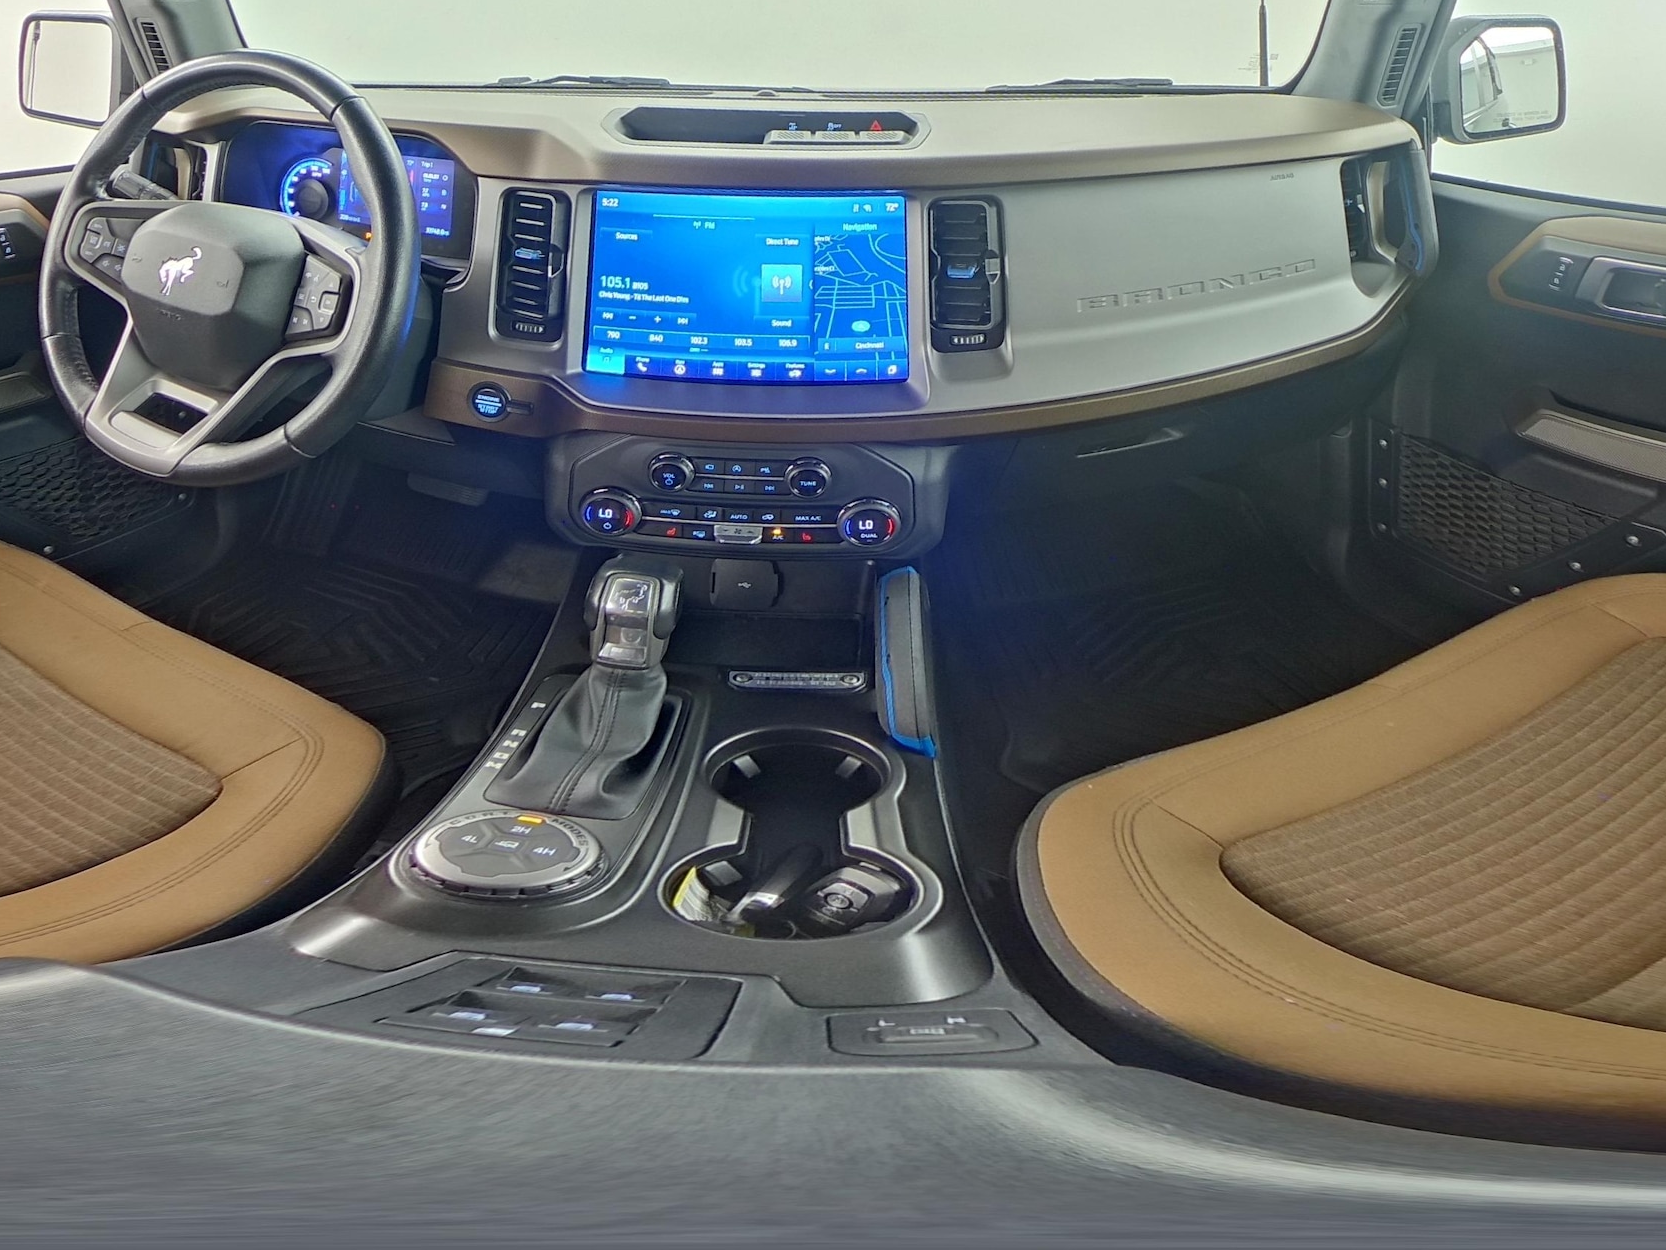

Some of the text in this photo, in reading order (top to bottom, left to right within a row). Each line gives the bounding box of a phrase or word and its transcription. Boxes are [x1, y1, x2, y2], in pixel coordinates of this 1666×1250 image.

[602, 198, 619, 207] 5:22
[705, 222, 715, 230] FM
[843, 222, 877, 232] Navigation
[615, 232, 638, 240] Sources
[766, 238, 799, 246] Direct Tune
[600, 275, 631, 289] 105.1
[1077, 258, 1316, 312] BRONCO
[614, 292, 630, 300] Young
[652, 294, 665, 302] Last
[771, 319, 792, 327] Sound
[855, 342, 884, 350] Cincinnati
[598, 508, 613, 519] LO
[859, 520, 874, 530] LO
[503, 740, 519, 748] N
[485, 761, 503, 769] M
[511, 825, 532, 834] 2H
[552, 818, 589, 846] MODES
[461, 834, 479, 844] 4L
[532, 846, 557, 856] 4H
